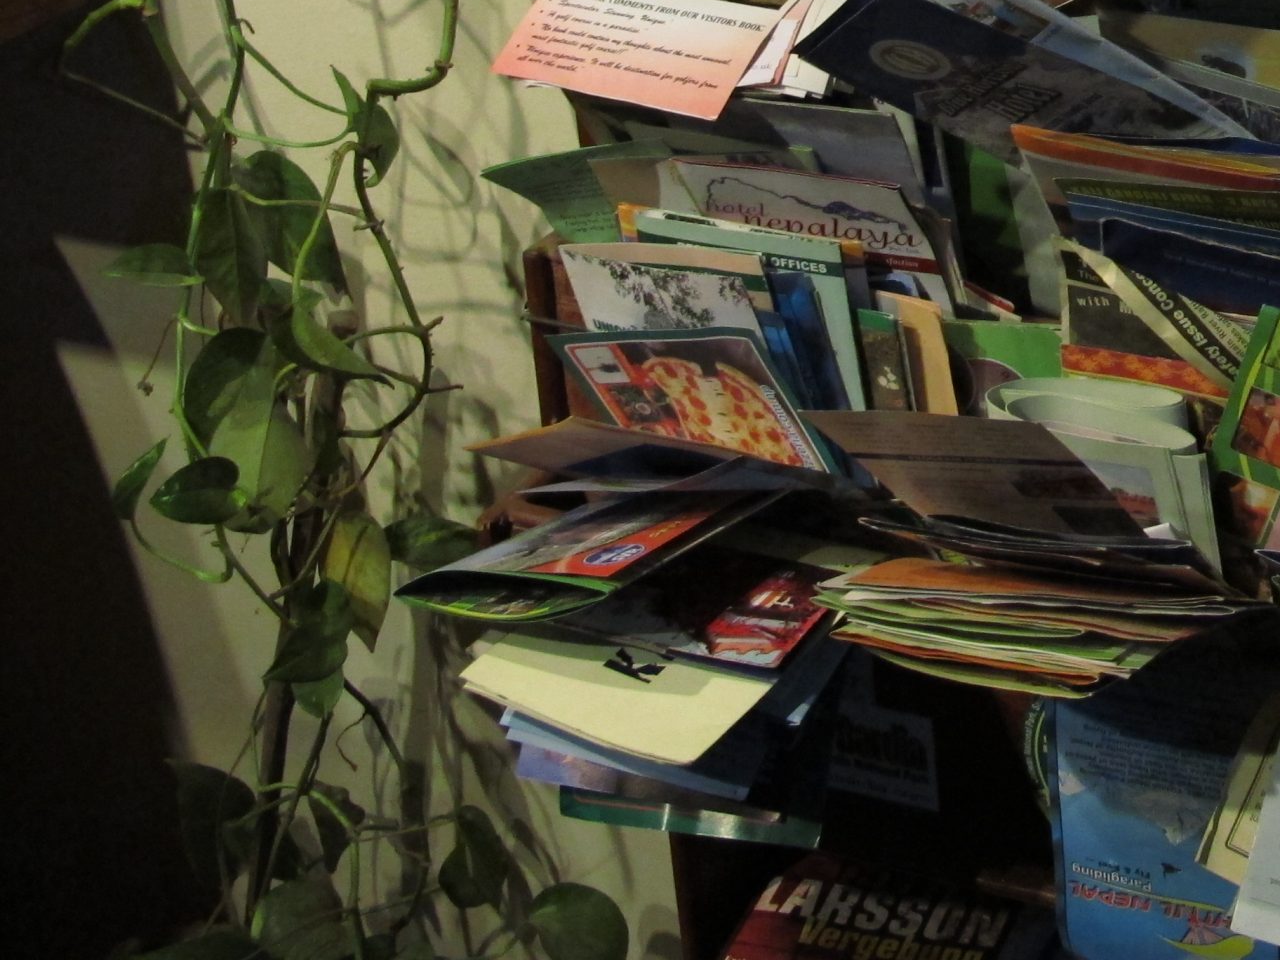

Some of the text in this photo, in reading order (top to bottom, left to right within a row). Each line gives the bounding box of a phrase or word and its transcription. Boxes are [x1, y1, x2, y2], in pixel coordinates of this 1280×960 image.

[657, 3, 680, 16] FROM
[682, 8, 699, 20] OUR
[700, 12, 738, 28] VISITORS
[706, 198, 764, 216] hotel
[745, 215, 923, 249] nepalaya
[770, 256, 827, 273] OFFICES
[1076, 297, 1110, 306] with
[1170, 307, 1211, 349] Issue
[1072, 862, 1152, 893] Paragliding
[753, 876, 1010, 948] LARSSON
[1072, 882, 1151, 912] NEPAL
